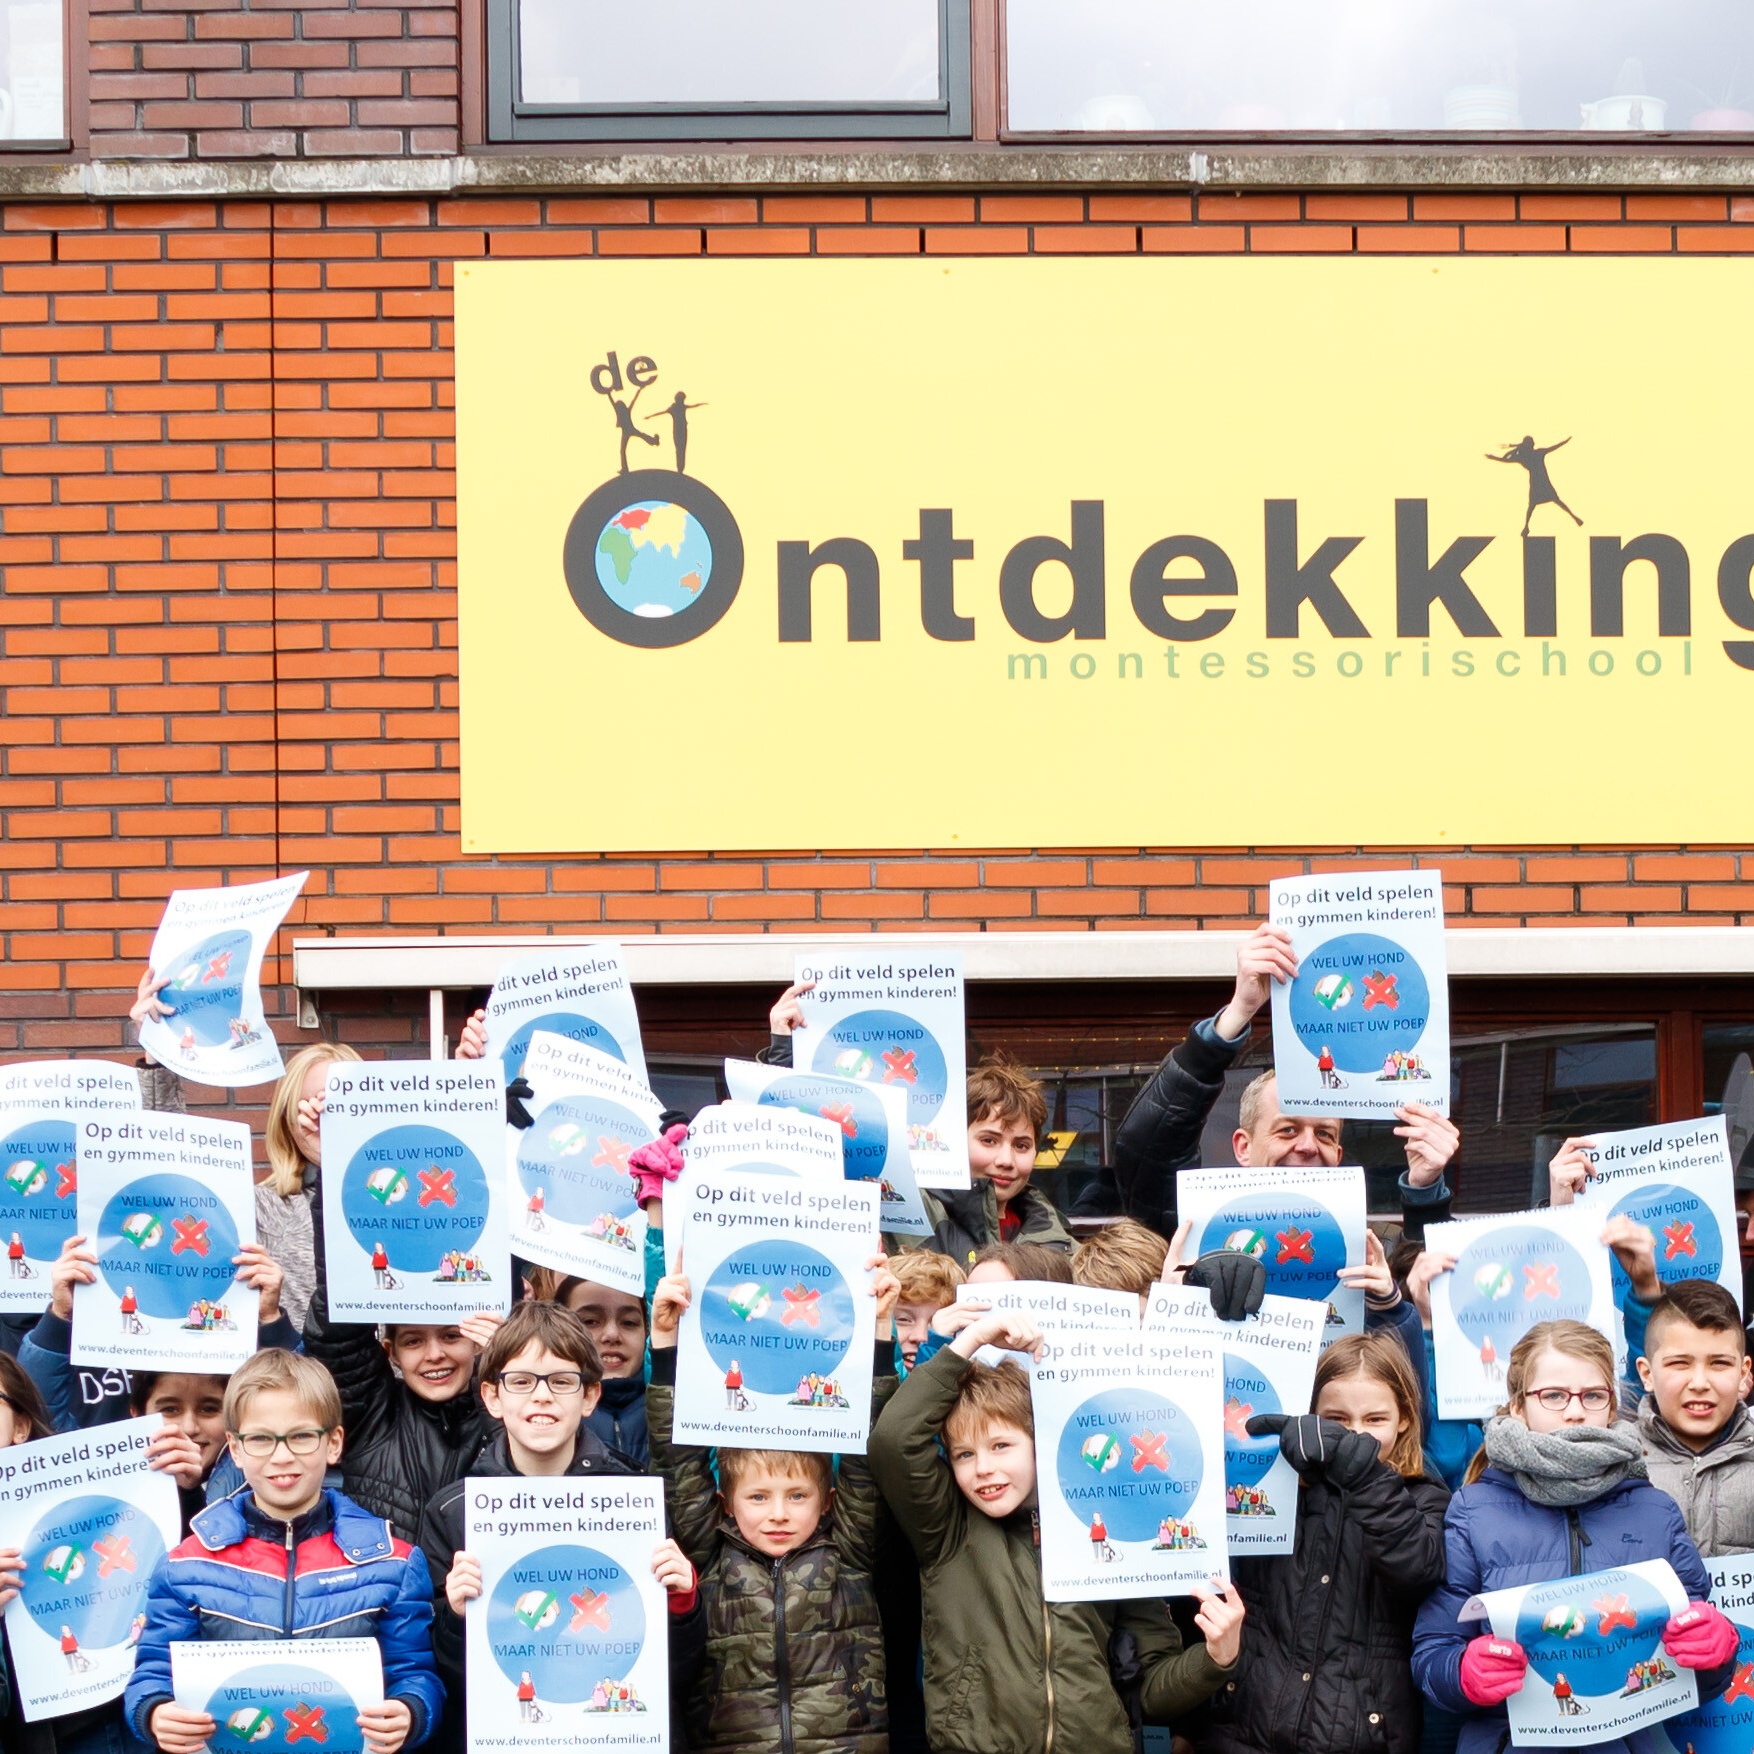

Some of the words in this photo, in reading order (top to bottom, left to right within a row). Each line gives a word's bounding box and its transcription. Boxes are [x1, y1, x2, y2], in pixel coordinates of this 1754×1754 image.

[590, 351, 658, 394] de
[1006, 641, 1694, 680] montessorischool
[1277, 892, 1301, 908] Op
[1306, 888, 1330, 903] dit
[1335, 886, 1372, 902] veld
[1377, 884, 1433, 904] spelen
[1276, 916, 1293, 924] en
[1297, 912, 1363, 928] gymmen
[1367, 906, 1436, 921] kinderen!
[1311, 957, 1339, 969] WEL
[1341, 954, 1365, 967] UW
[1367, 951, 1405, 965] HOND
[1296, 1022, 1334, 1034] MAAR
[1337, 1020, 1365, 1033] NIET
[1367, 1019, 1390, 1032] UW
[1393, 1017, 1425, 1031] POEP
[329, 1077, 353, 1096] Op
[358, 1076, 385, 1092] dit
[389, 1075, 430, 1091] veld
[435, 1074, 496, 1094] spelen
[326, 1103, 345, 1113] en
[349, 1103, 419, 1117] gymmen
[423, 1098, 498, 1112] kinderen!
[85, 1122, 113, 1142] Op
[118, 1123, 143, 1140] dit
[148, 1126, 185, 1142] veld
[189, 1133, 243, 1151] spelen
[1666, 1131, 1719, 1153] spelen
[83, 1149, 103, 1159] en
[107, 1150, 175, 1163] gymmen
[179, 1150, 245, 1171] kinderen!
[364, 1149, 394, 1161] WEL
[396, 1147, 421, 1160] UW
[424, 1145, 464, 1159] HOND
[121, 1195, 150, 1207] WEL
[152, 1196, 176, 1208] UW
[179, 1196, 218, 1208] HOND
[696, 1184, 724, 1205] Op
[729, 1187, 755, 1203] dit
[762, 1190, 802, 1207] veld
[808, 1194, 871, 1212] spelen
[348, 1217, 388, 1229] MAAR
[391, 1217, 420, 1230] NIET
[423, 1217, 448, 1230] UW
[451, 1216, 485, 1229] POEP
[692, 1211, 712, 1222] en
[717, 1213, 789, 1227] gymmen
[794, 1215, 872, 1234] kinderen!
[100, 1259, 141, 1273] MAAR
[144, 1262, 173, 1276] NIET
[175, 1265, 199, 1278] UW
[202, 1263, 237, 1279] POEP
[728, 1262, 758, 1275] WEL
[762, 1263, 787, 1276] UW
[790, 1264, 832, 1277] HOND
[335, 1301, 505, 1312] www.deventerschoonfamilie.nl
[705, 1331, 746, 1346] MAAR
[750, 1335, 781, 1349] NIET
[784, 1337, 809, 1350] UW
[812, 1338, 850, 1352] POEP
[680, 1421, 861, 1439] www.deventerschoonfamilie.nl
[474, 1493, 503, 1514] Op
[509, 1492, 536, 1510] dit
[542, 1492, 584, 1509] veld
[590, 1492, 655, 1513] spelen
[473, 1522, 493, 1533] en
[498, 1521, 572, 1537] gymmen
[577, 1517, 657, 1532] kinderen!
[513, 1570, 544, 1584] WEL
[547, 1569, 573, 1582] UW
[577, 1567, 619, 1581] HOND
[494, 1644, 536, 1657] MAAR
[540, 1643, 572, 1657] NIET
[575, 1643, 601, 1656] UW
[605, 1641, 640, 1655] POEP
[1517, 1690, 1691, 1734] www.deventerschoonfamilie.nl
[474, 1733, 661, 1746] www.deventerschoonfamilie.nl
